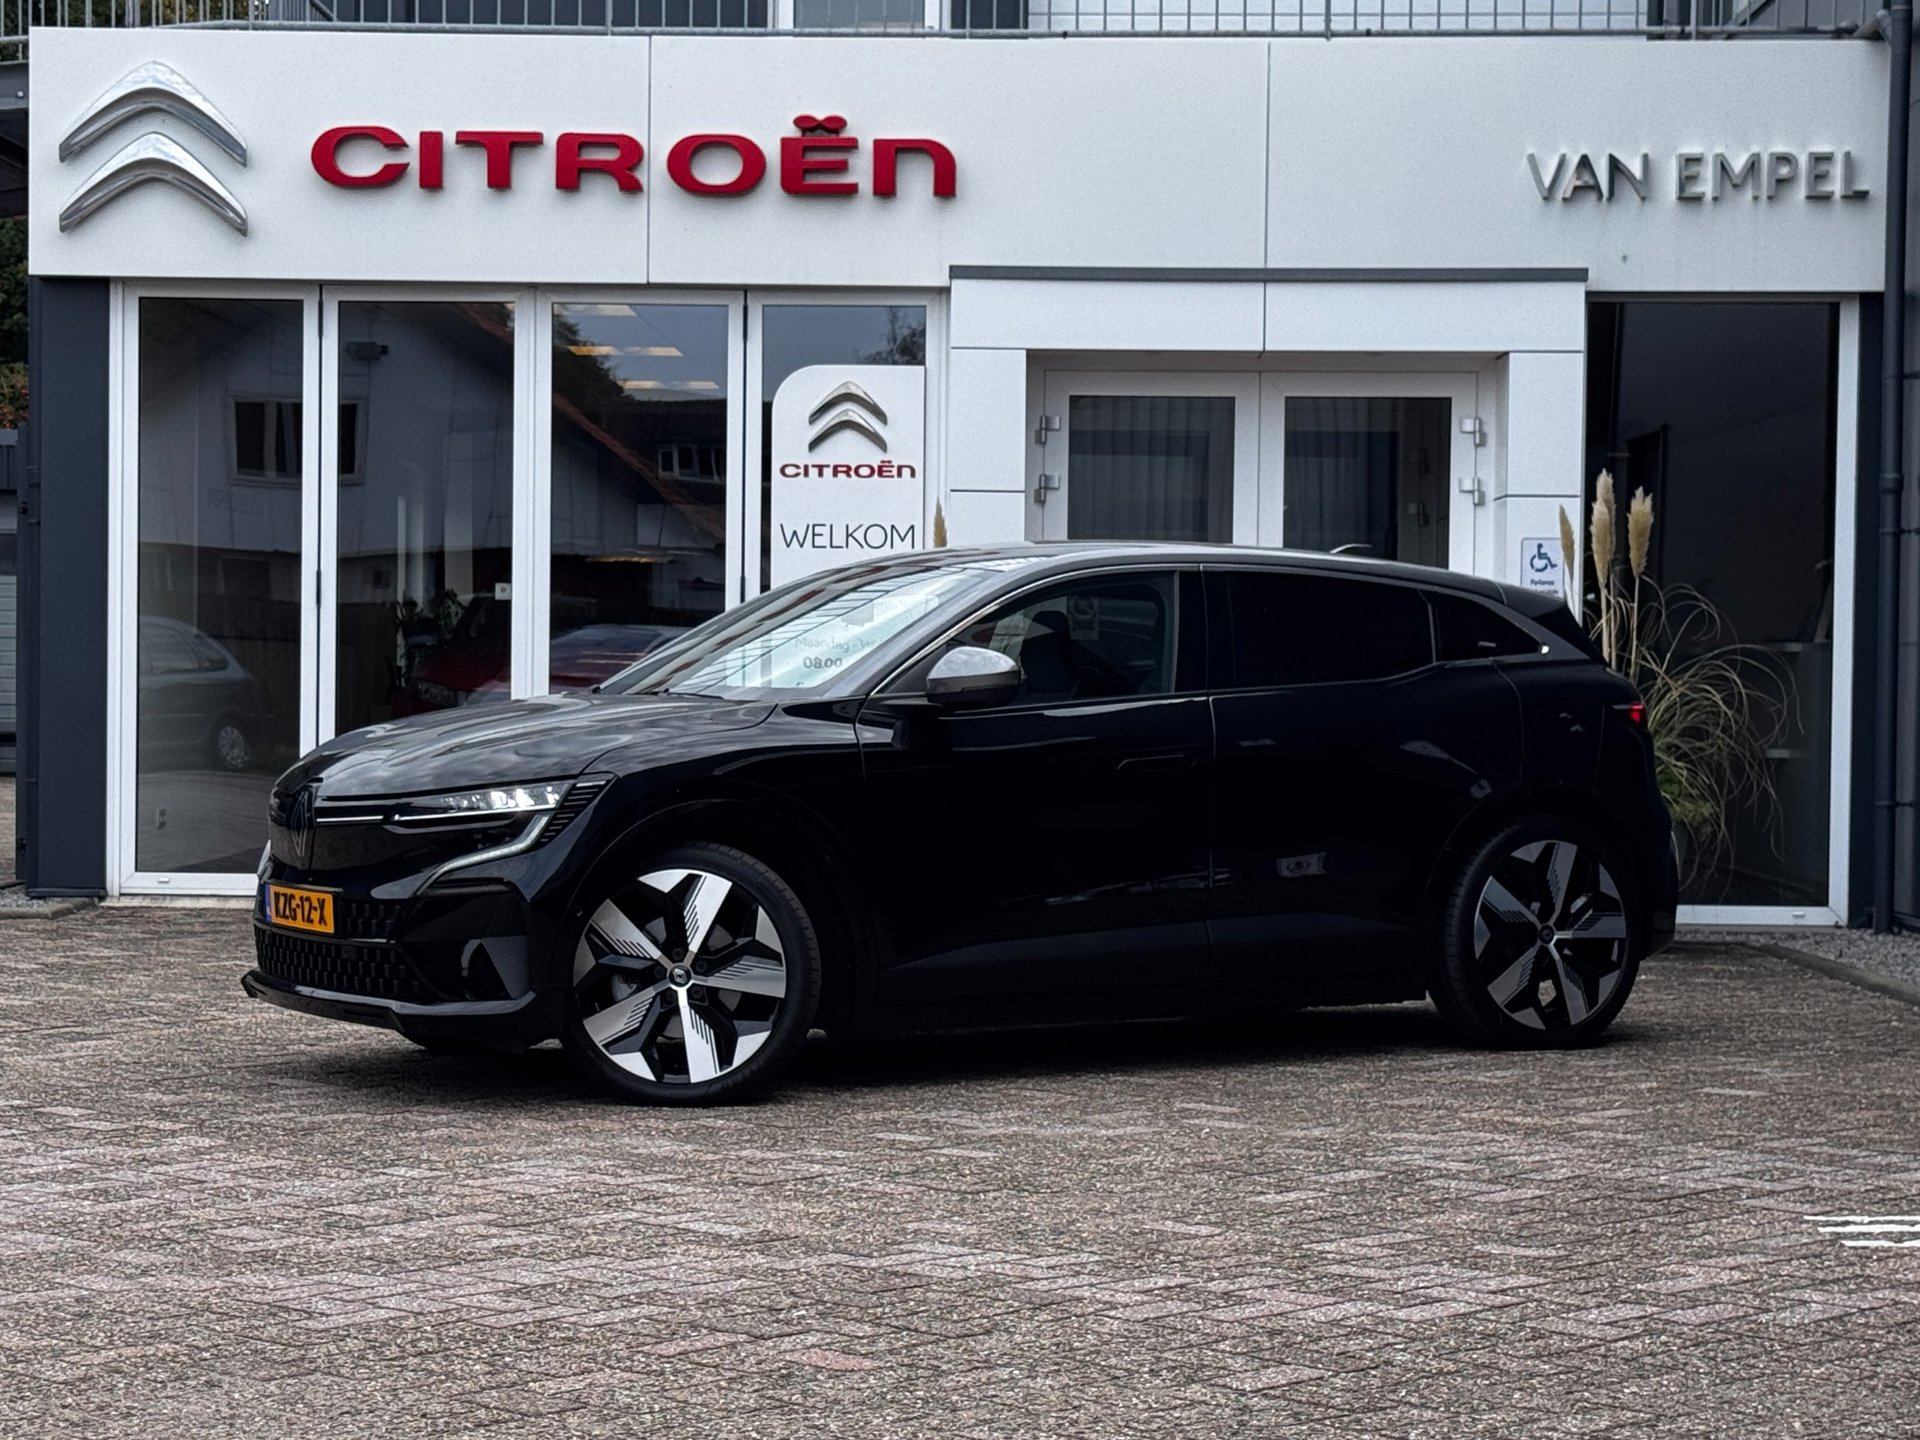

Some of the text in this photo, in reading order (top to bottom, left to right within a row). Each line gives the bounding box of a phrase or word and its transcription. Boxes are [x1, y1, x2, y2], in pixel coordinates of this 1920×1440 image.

[1526, 150, 1871, 201] VAN EMPEL
[780, 523, 915, 549] WELKOM
[795, 638, 850, 653] Maandag
